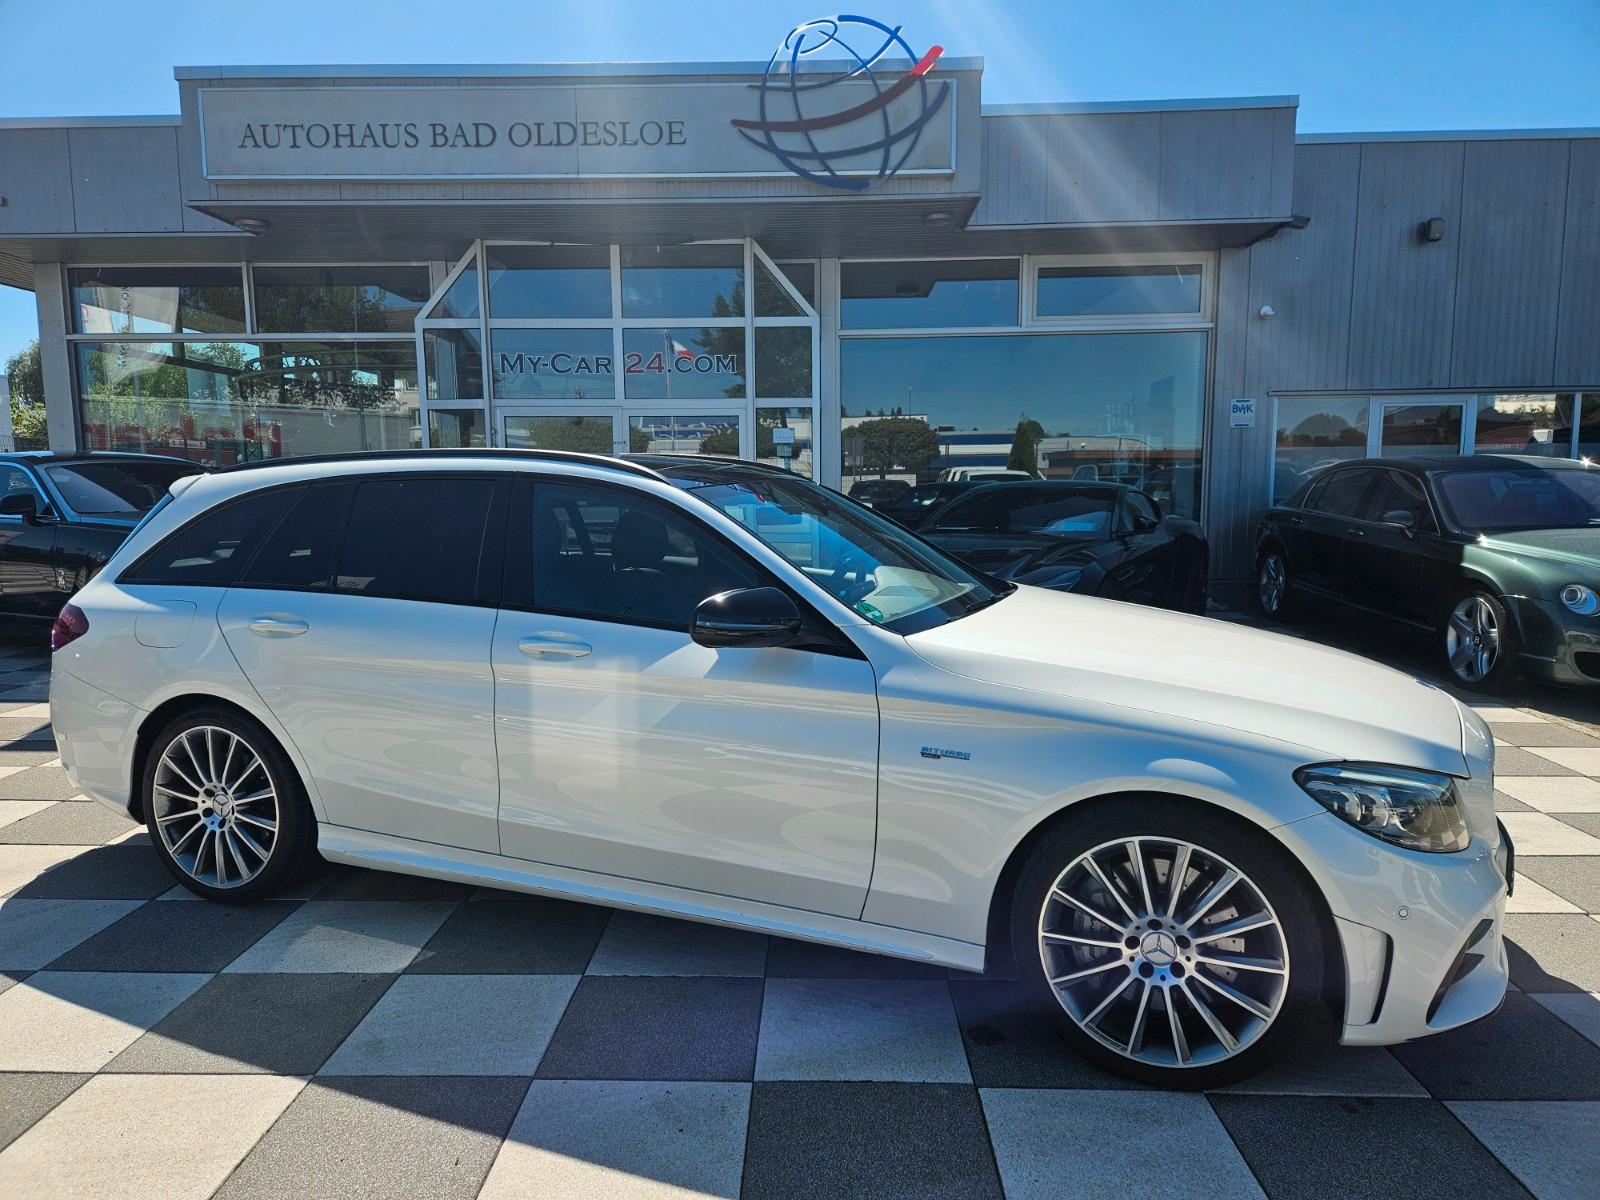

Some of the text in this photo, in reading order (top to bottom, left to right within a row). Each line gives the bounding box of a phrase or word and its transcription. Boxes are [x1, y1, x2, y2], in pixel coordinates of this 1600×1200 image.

[238, 119, 688, 149] AUTOHAUS BAD OLDESLOE
